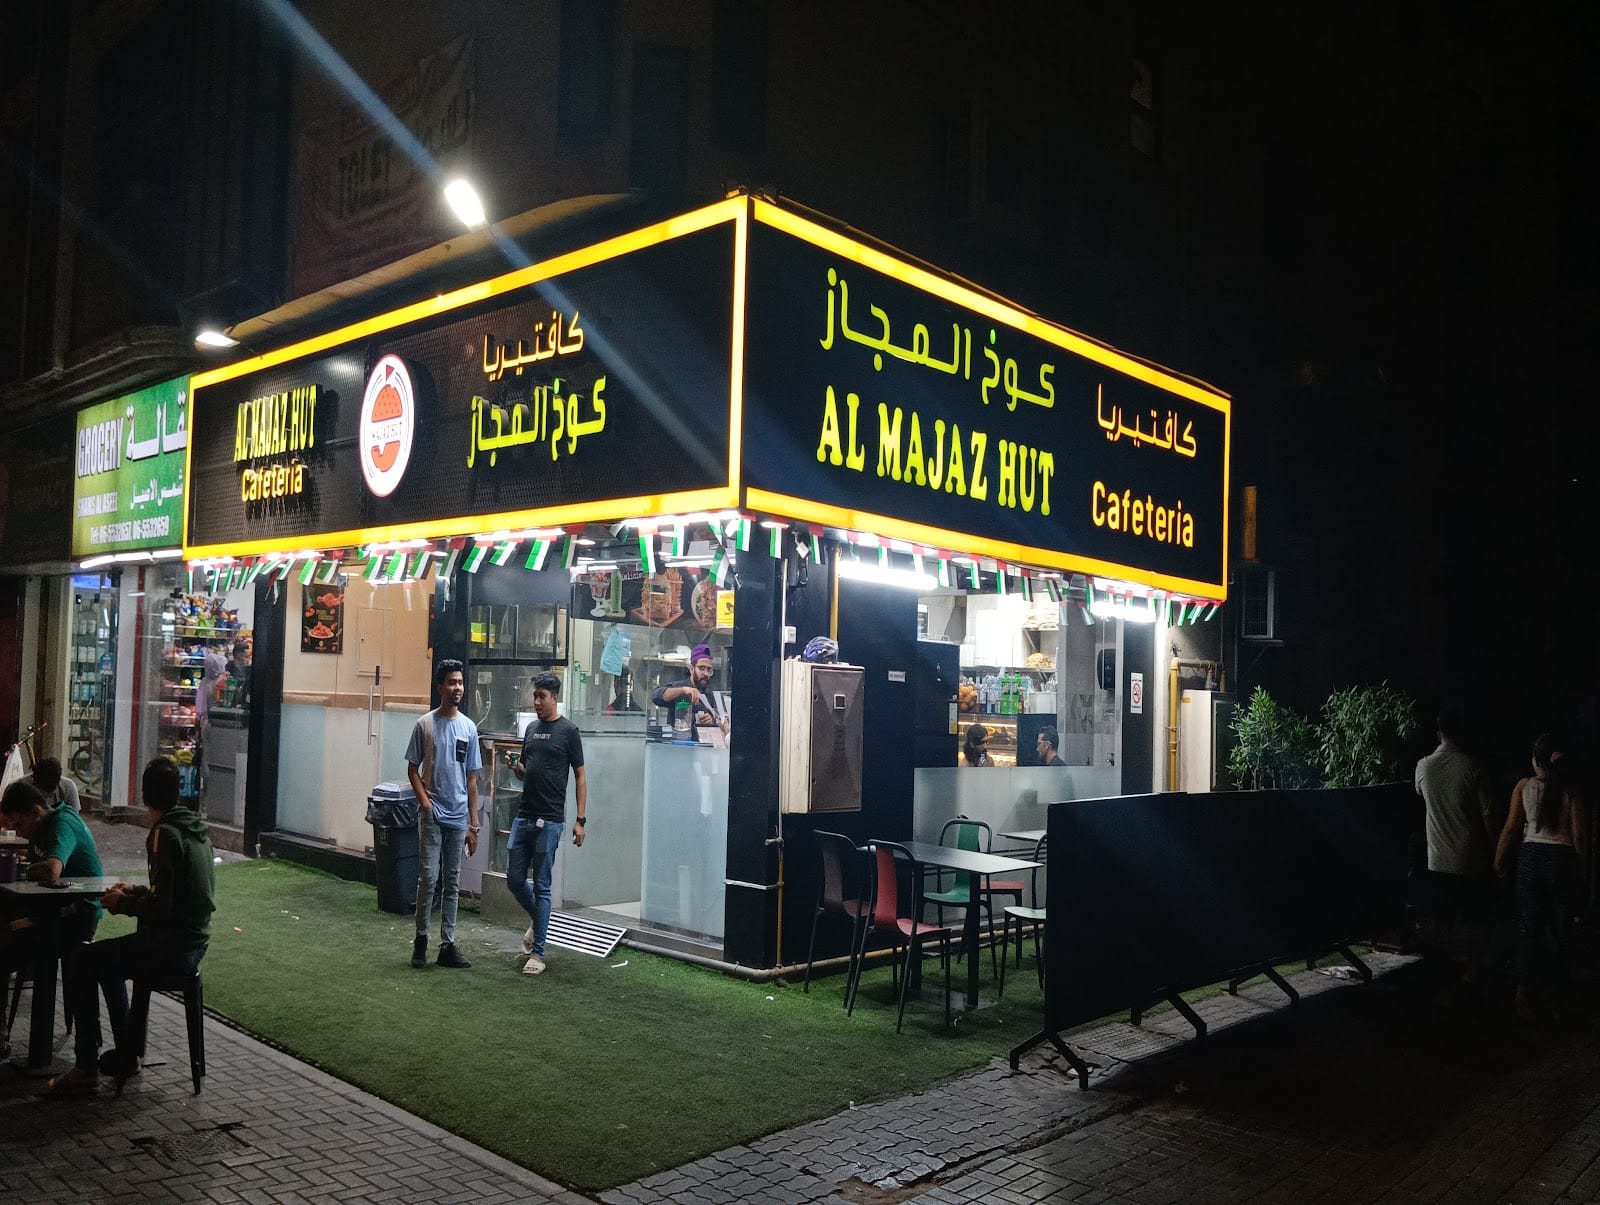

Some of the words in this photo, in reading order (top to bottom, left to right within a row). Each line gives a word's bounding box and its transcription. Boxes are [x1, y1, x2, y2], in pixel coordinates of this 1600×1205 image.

[483, 311, 584, 381] كافتيريا
[819, 267, 971, 380] المجاز
[78, 418, 124, 478] GROCERY
[234, 402, 249, 462] AL
[249, 391, 288, 459] MAJAZ
[290, 384, 317, 451] HUT
[466, 386, 548, 468] المجاز
[817, 385, 865, 472] AL
[876, 402, 987, 501] MAJAZ
[998, 439, 1054, 516] HUT
[1097, 383, 1197, 458] كافتيريا
[242, 461, 303, 502] Cafeteria
[1092, 481, 1194, 548] Cafeteria
